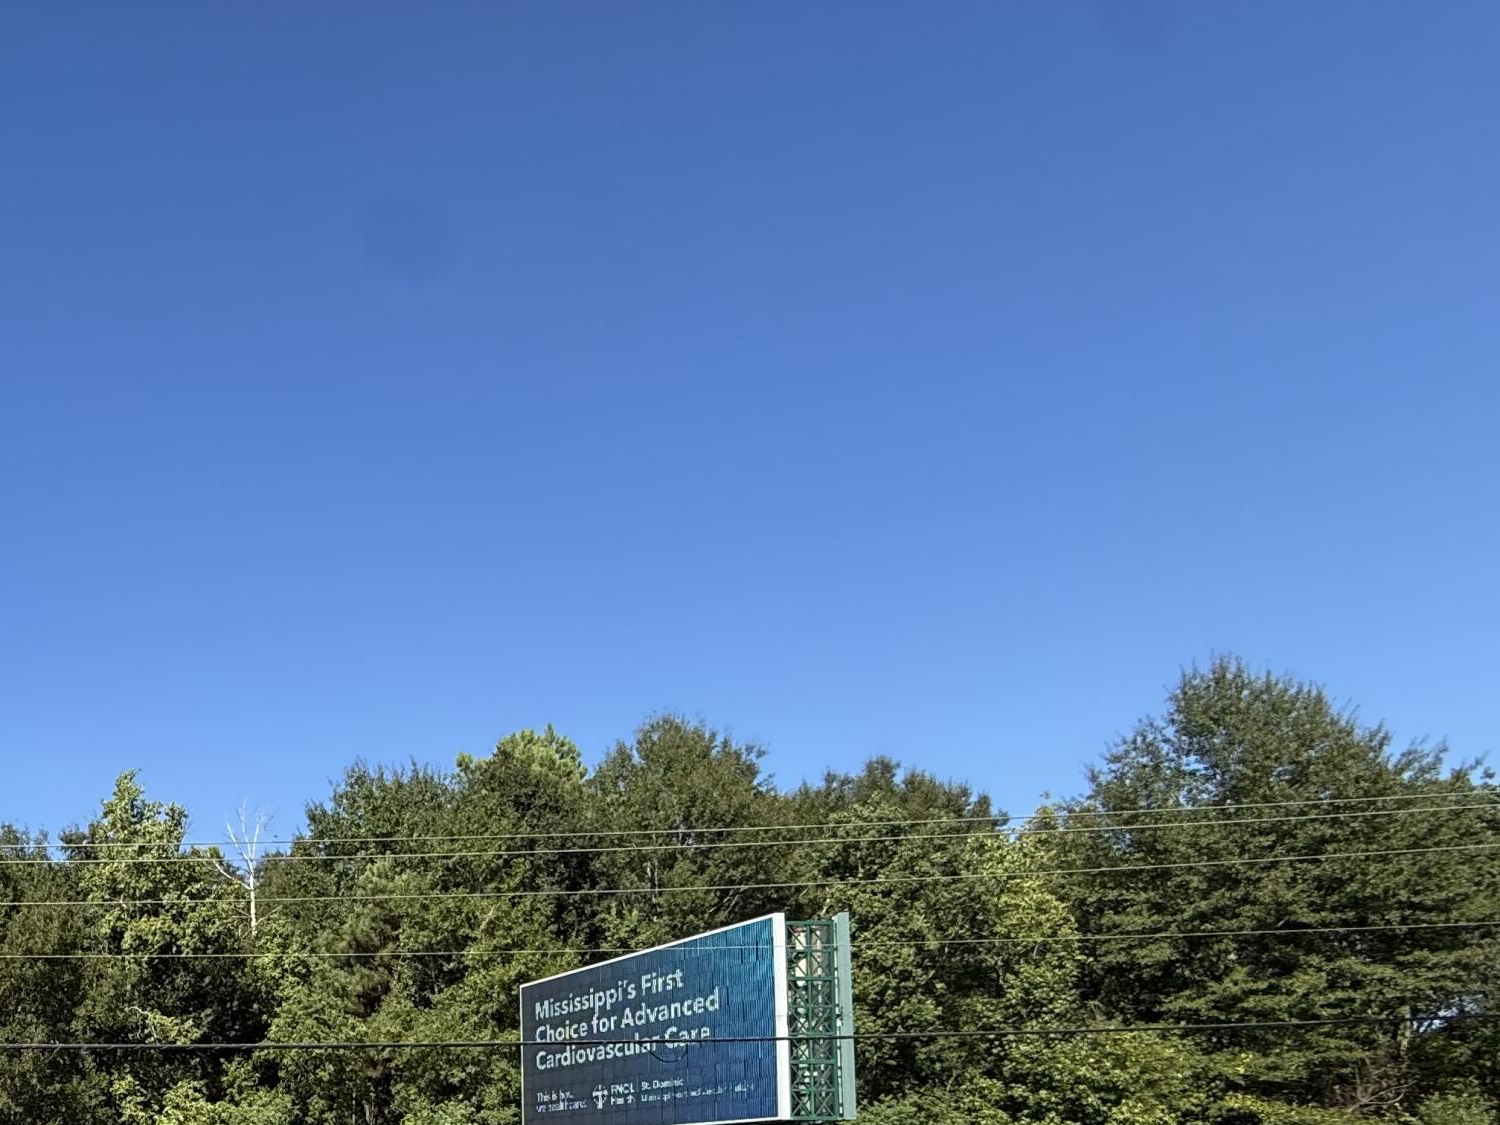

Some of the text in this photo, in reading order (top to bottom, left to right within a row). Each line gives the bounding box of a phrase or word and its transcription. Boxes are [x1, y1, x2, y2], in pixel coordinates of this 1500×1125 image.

[535, 969, 683, 1020] Mississippi's First
[535, 986, 720, 1043] Choice for Advanced
[536, 1026, 711, 1070] Cardiovascular Care
